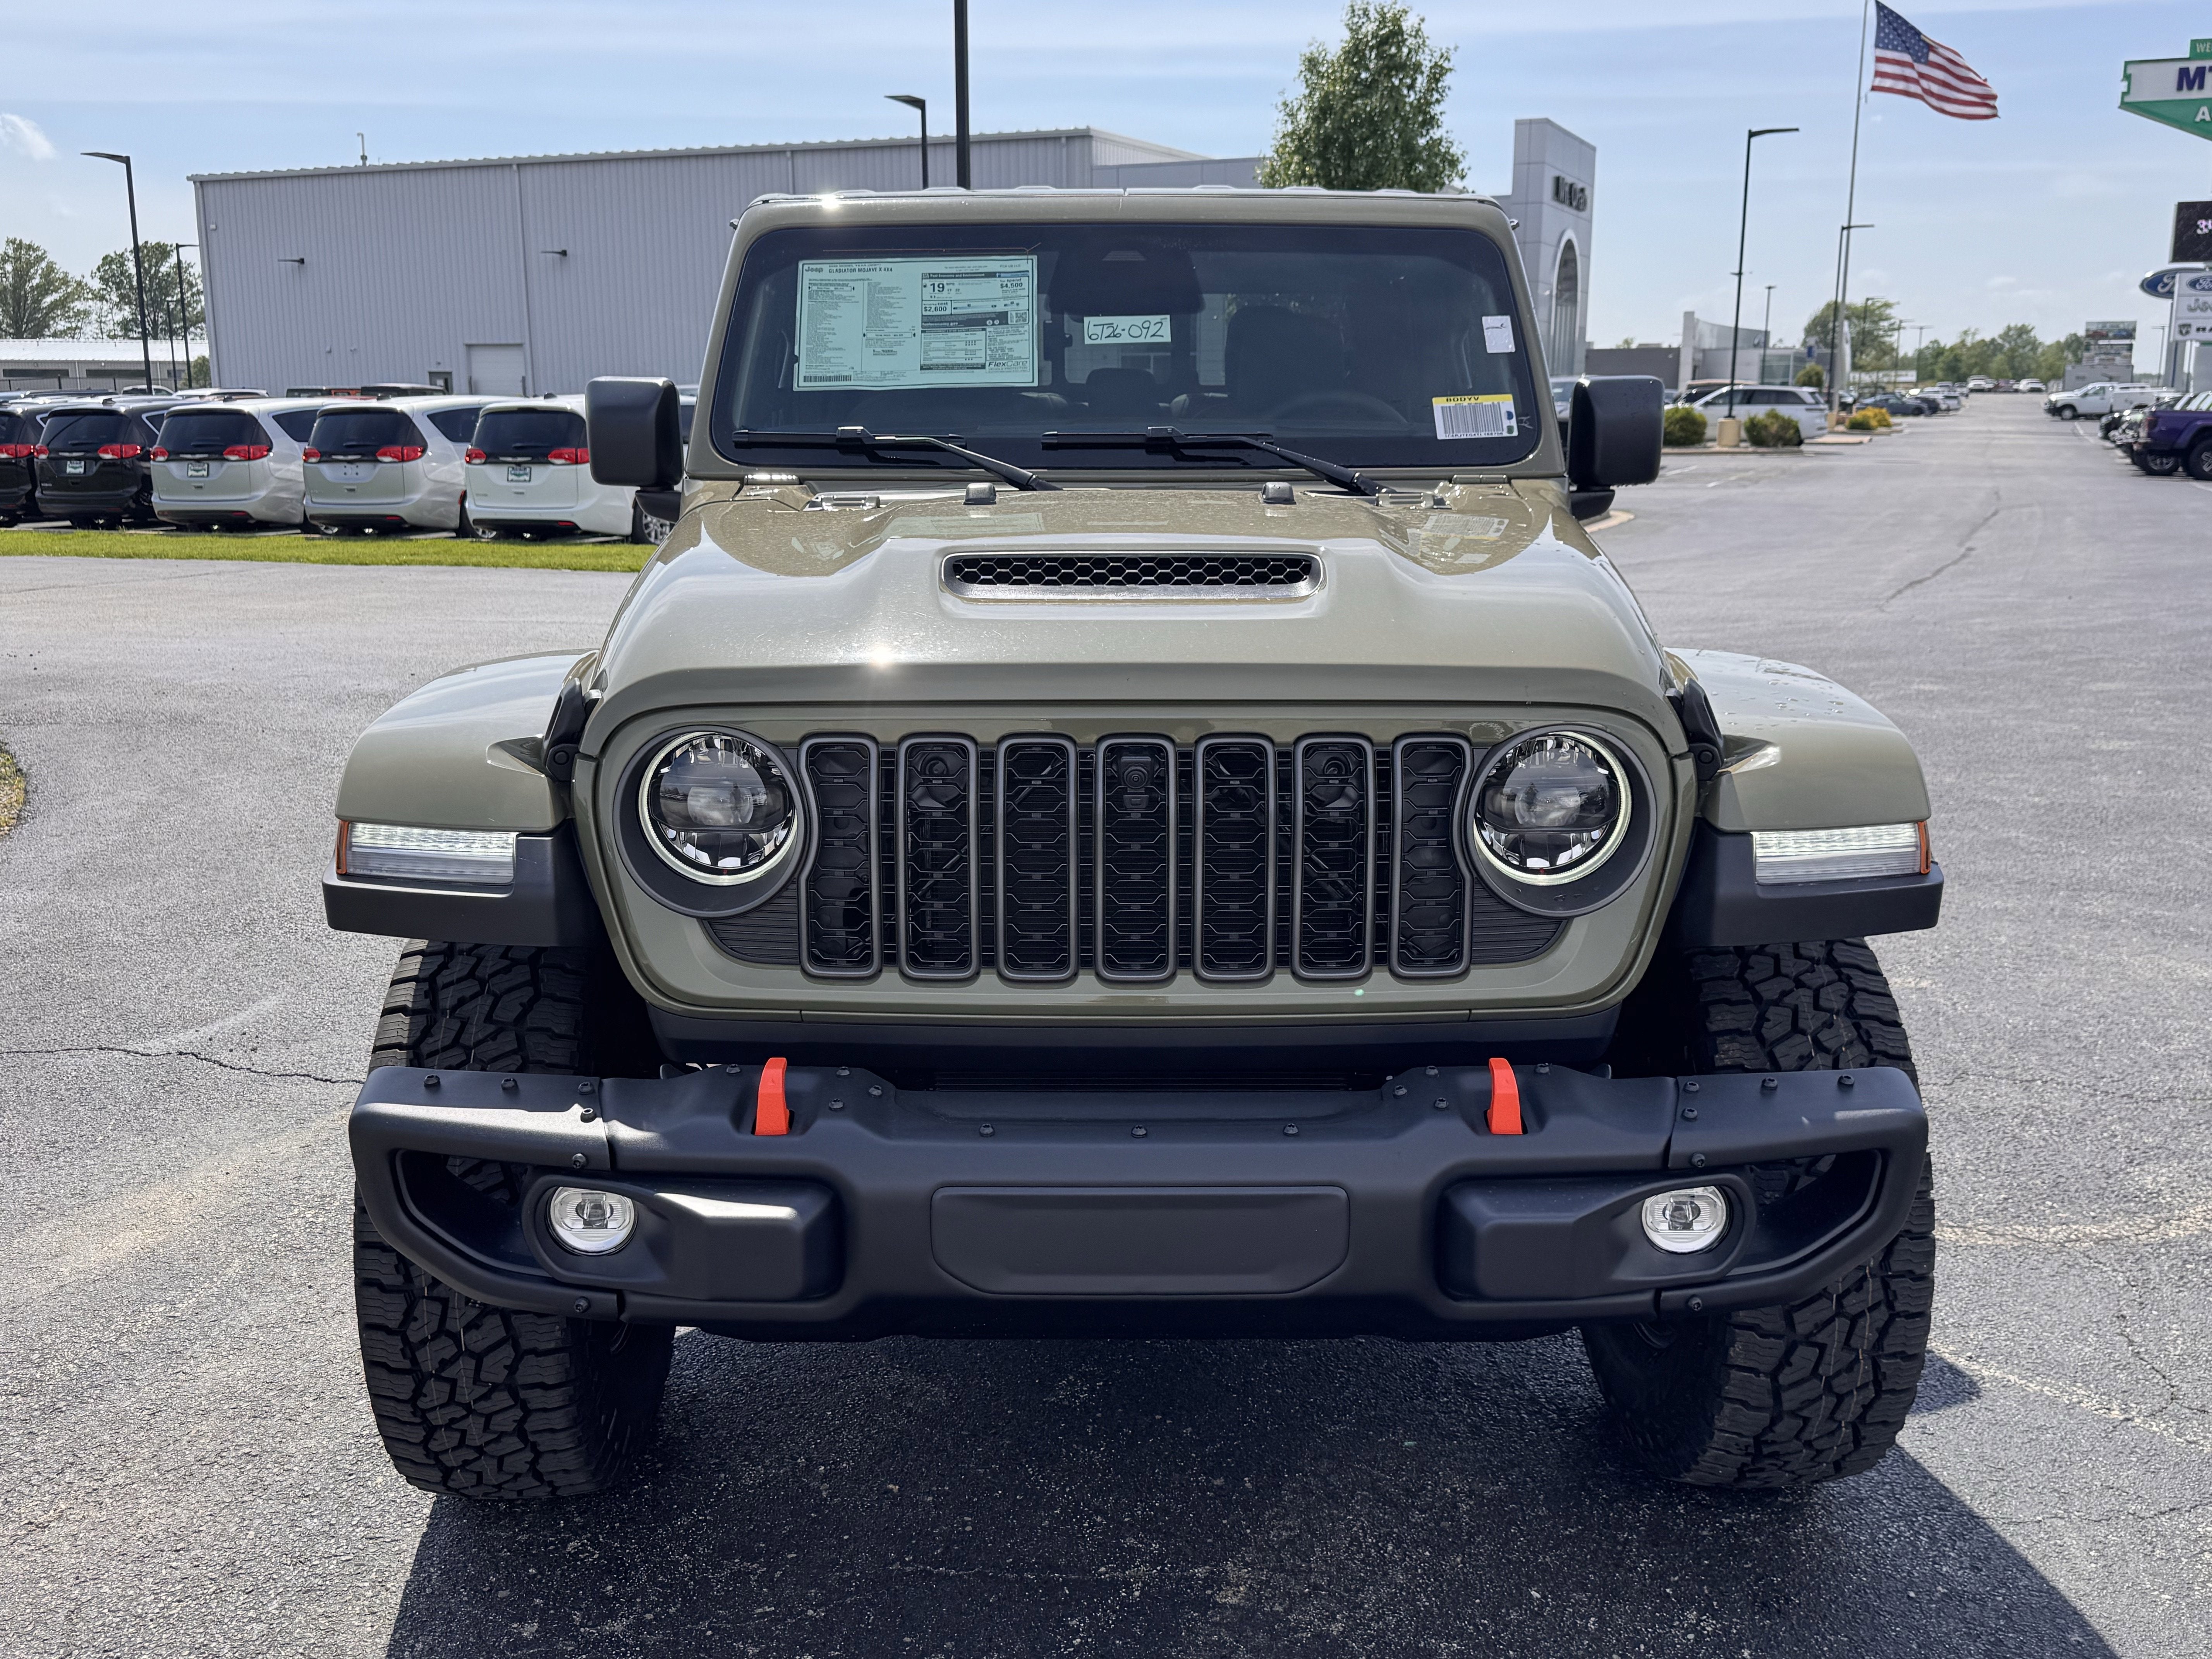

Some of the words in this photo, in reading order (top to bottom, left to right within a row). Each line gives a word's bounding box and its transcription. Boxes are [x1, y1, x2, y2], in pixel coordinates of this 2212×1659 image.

[2196, 42, 2212, 53] WE
[2176, 66, 2212, 91] M
[2194, 105, 2212, 122] A
[930, 282, 945, 292] 19
[2186, 298, 2212, 313] Je
